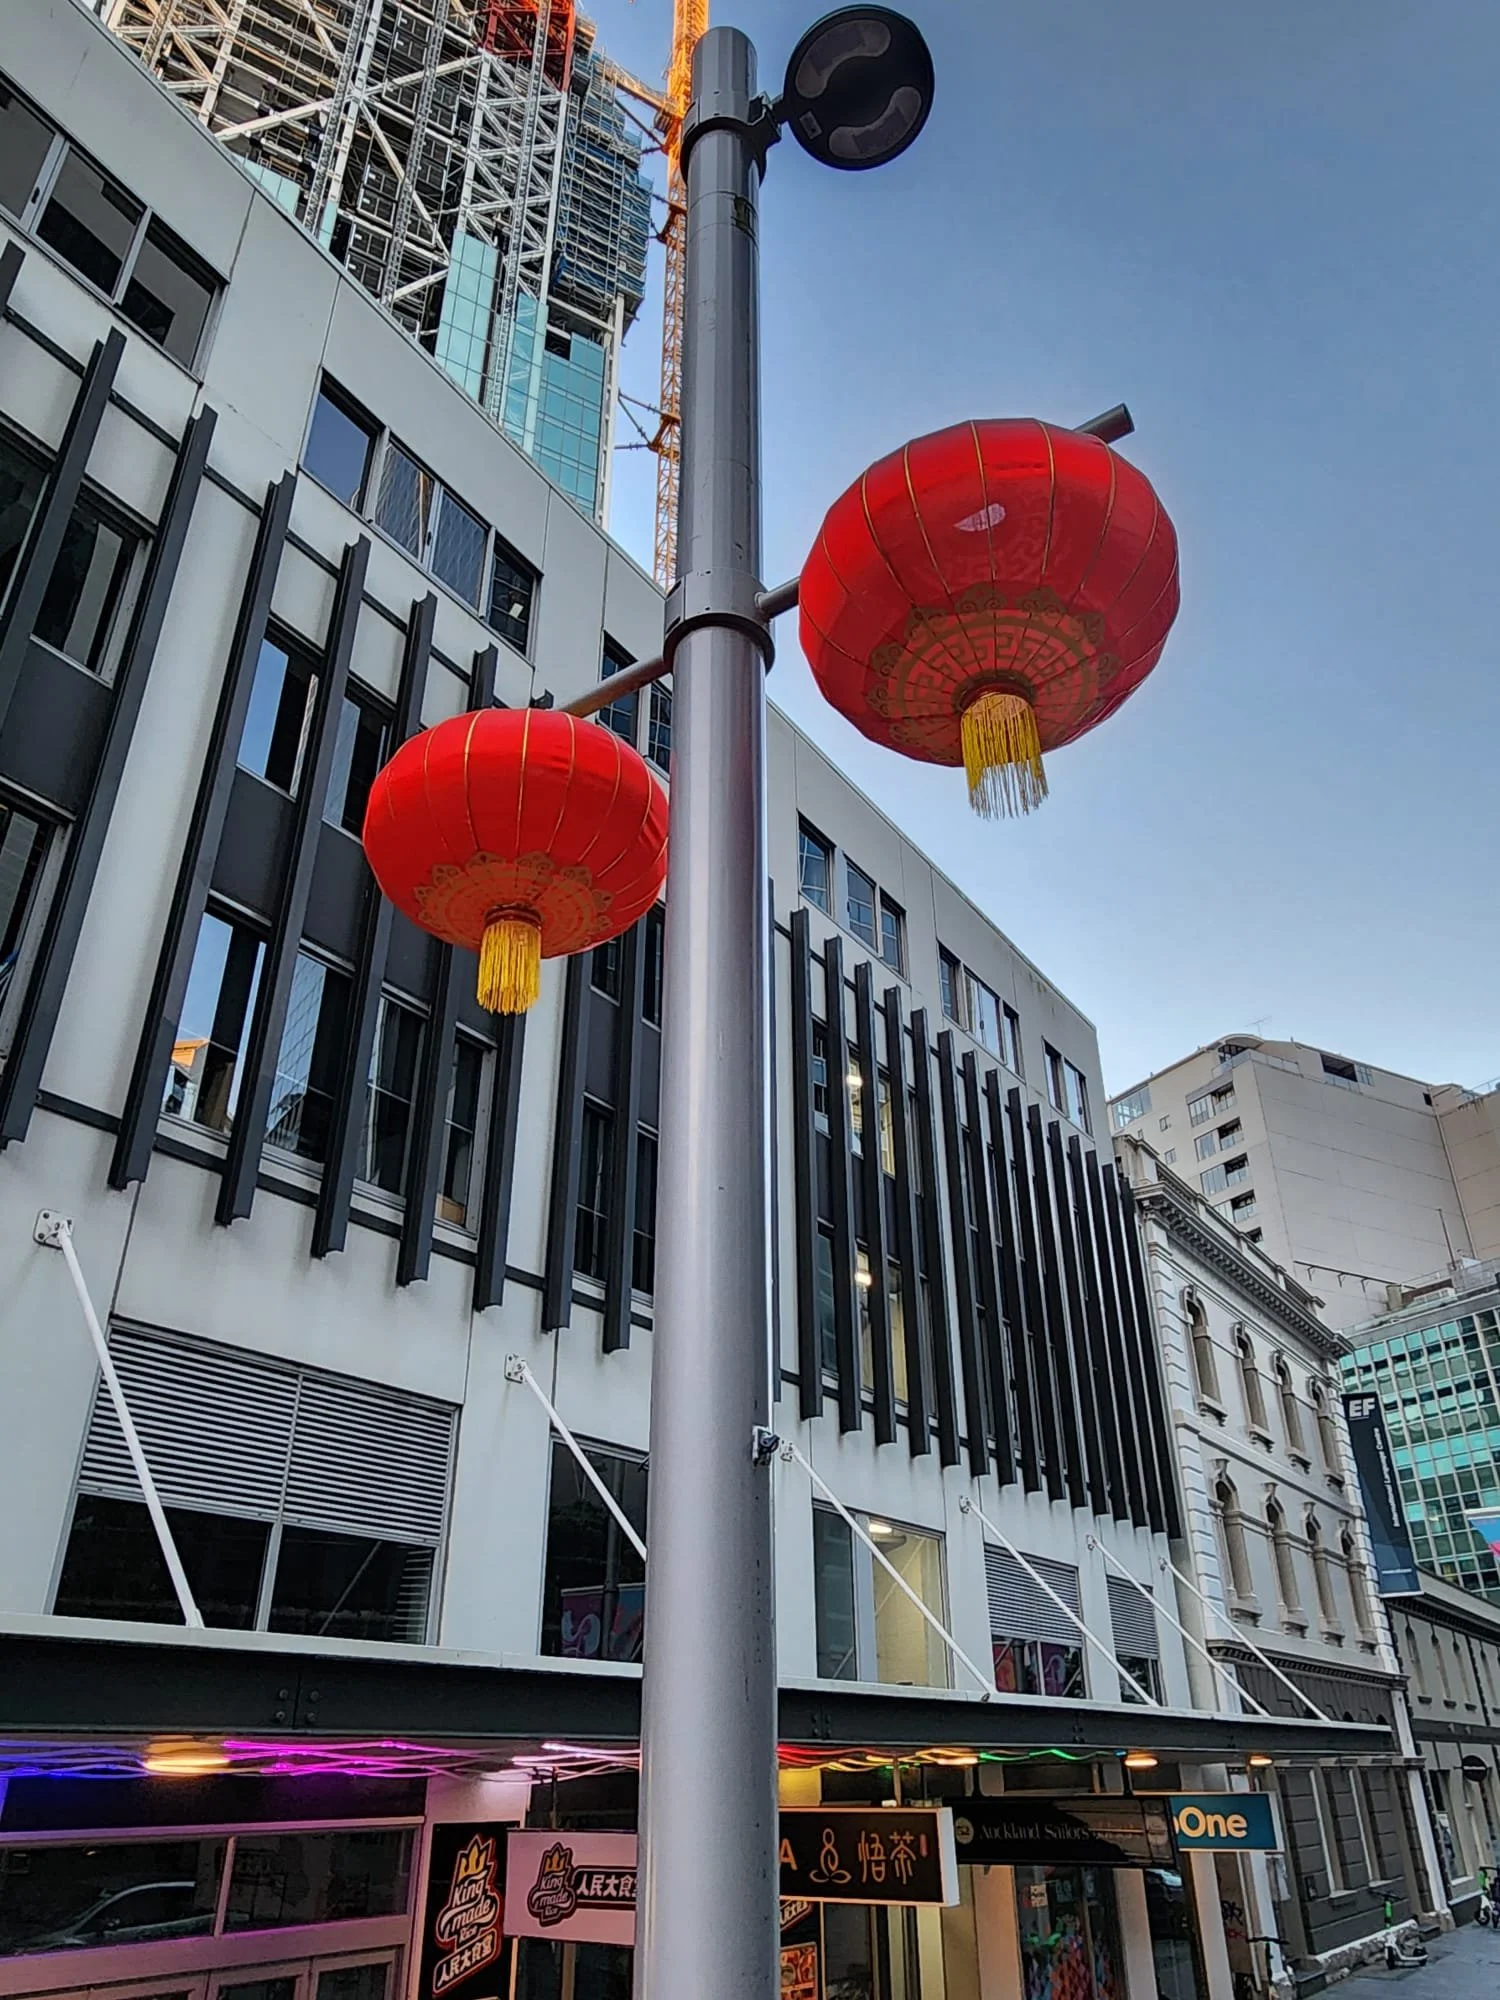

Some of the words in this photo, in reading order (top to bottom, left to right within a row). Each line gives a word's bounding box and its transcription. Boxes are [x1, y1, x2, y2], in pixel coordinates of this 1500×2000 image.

[1349, 1397, 1375, 1417] EF
[980, 1821, 1041, 1840] Auckland
[1172, 1806, 1248, 1839] One
[452, 1879, 485, 1908] King
[540, 1876, 564, 1890] King
[576, 1873, 637, 1898] 人民大食
[540, 1888, 570, 1906] made
[451, 1894, 491, 1932] made
